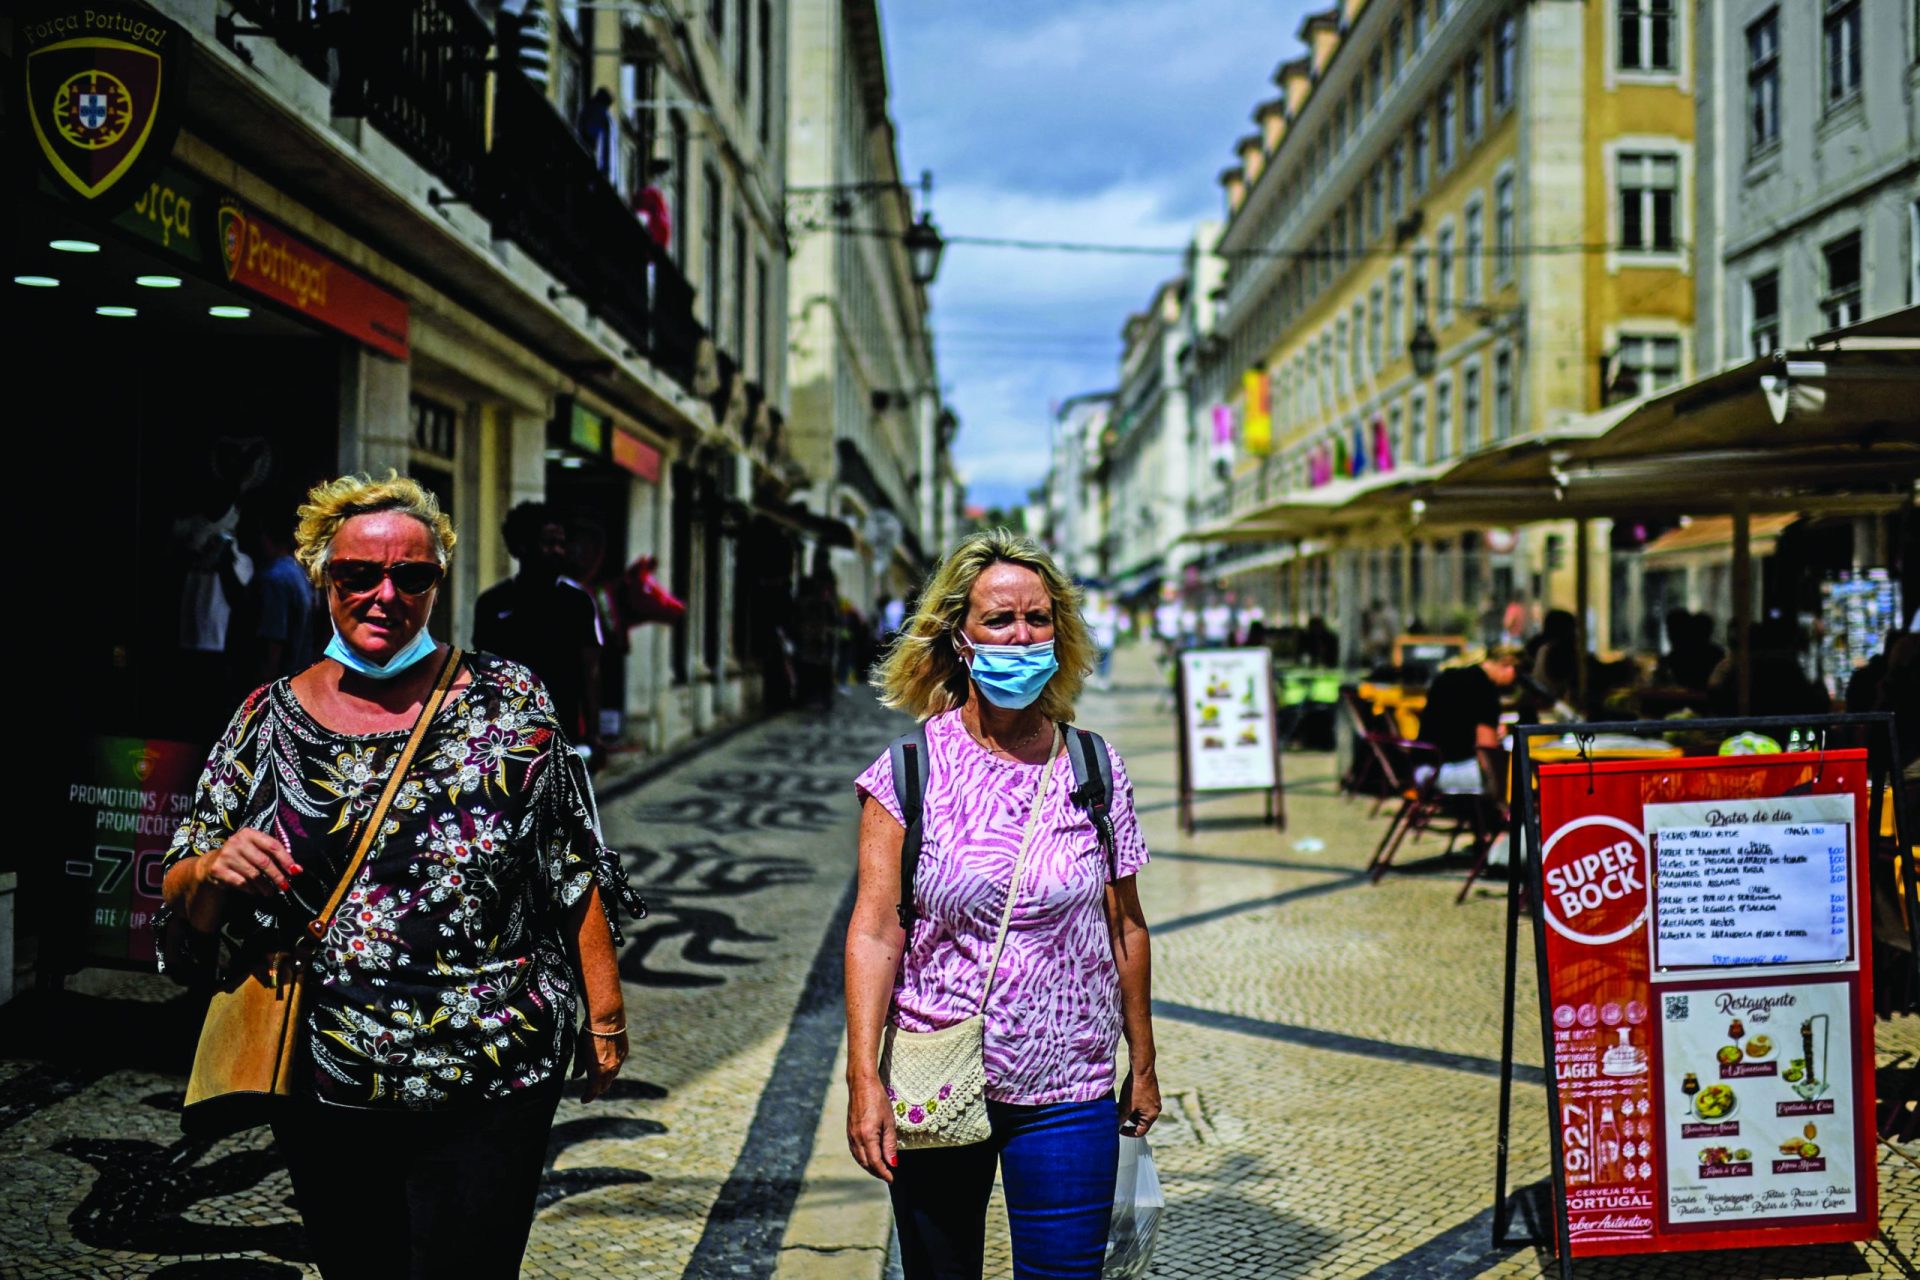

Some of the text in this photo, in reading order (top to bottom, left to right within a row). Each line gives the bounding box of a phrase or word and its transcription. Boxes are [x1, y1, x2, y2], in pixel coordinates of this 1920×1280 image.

[23, 10, 167, 46] Força Portugal
[246, 224, 328, 308] Portugal
[69, 784, 156, 811] PROMOTIONS
[96, 811, 180, 836] PROMOÇÕES
[1705, 808, 1792, 827] Pratos do dia
[1546, 841, 1638, 896] SUPER
[1559, 865, 1644, 919] BOCK
[130, 912, 147, 929] UP
[1714, 992, 1797, 1016] Restaurante
[1555, 1063, 1598, 1080] LAGER
[1563, 1103, 1590, 1185] 1927
[1575, 1188, 1620, 1197] CERVEJA
